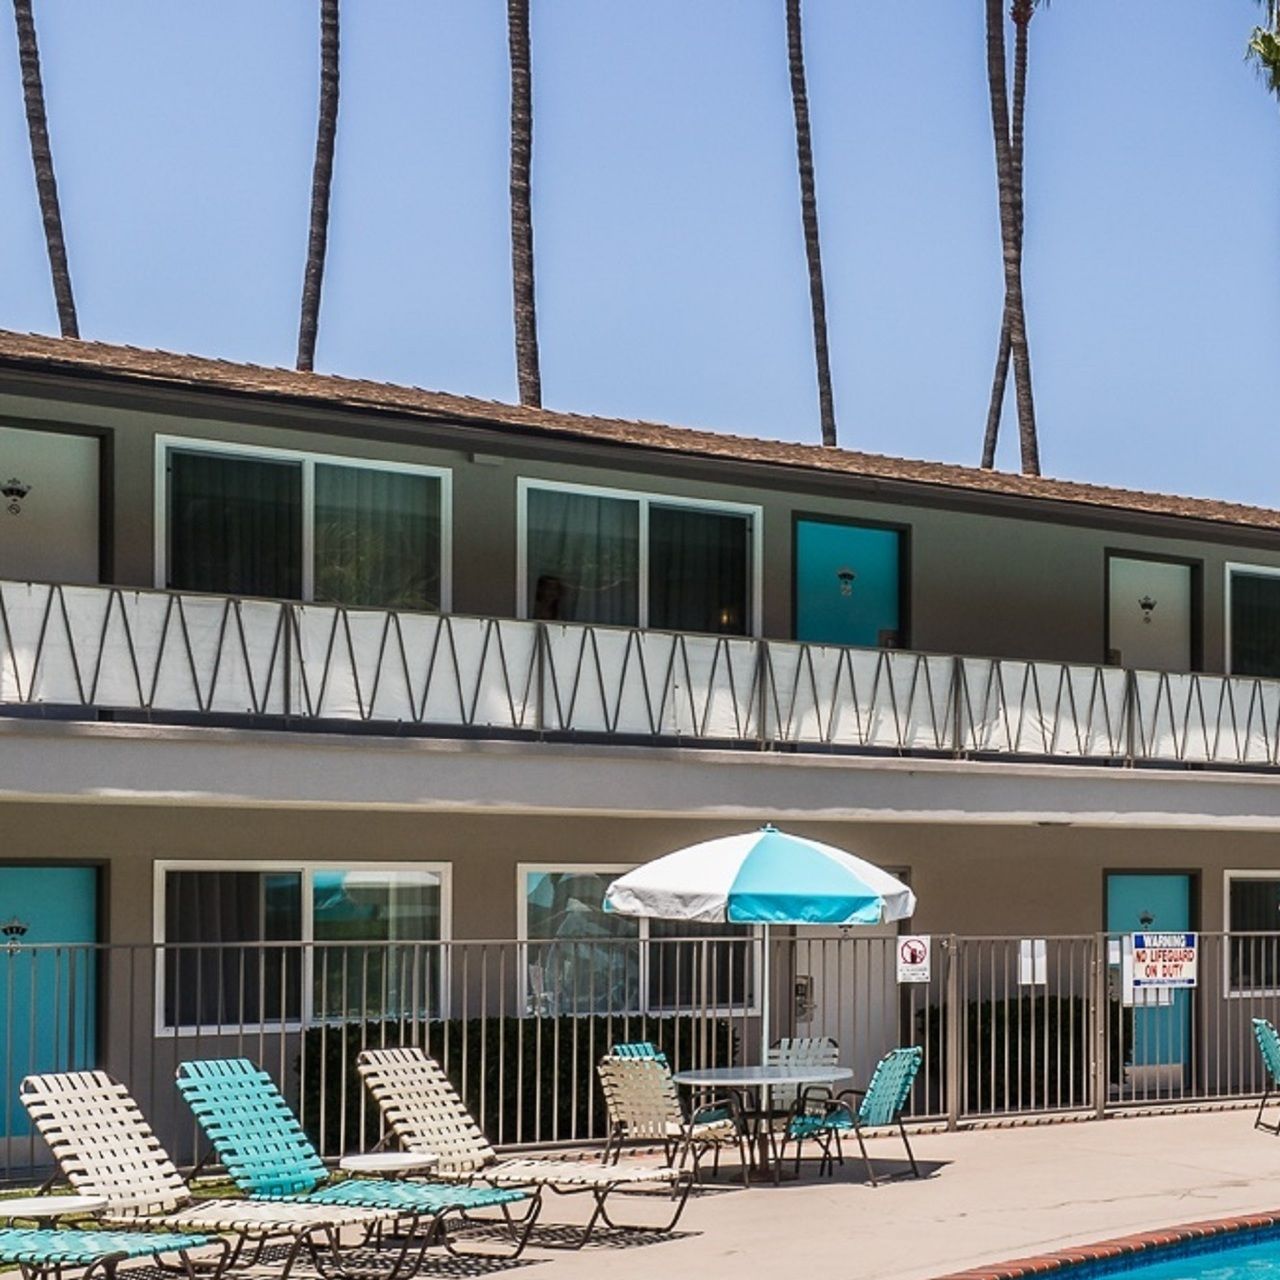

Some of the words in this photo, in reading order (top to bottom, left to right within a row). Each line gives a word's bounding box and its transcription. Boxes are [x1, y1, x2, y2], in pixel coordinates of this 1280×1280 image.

[1143, 934, 1186, 948] WARNING
[1136, 949, 1147, 963] NO
[1150, 949, 1195, 963] LIFEGUARD
[1145, 964, 1158, 978] ON
[1162, 964, 1183, 978] DUTY
